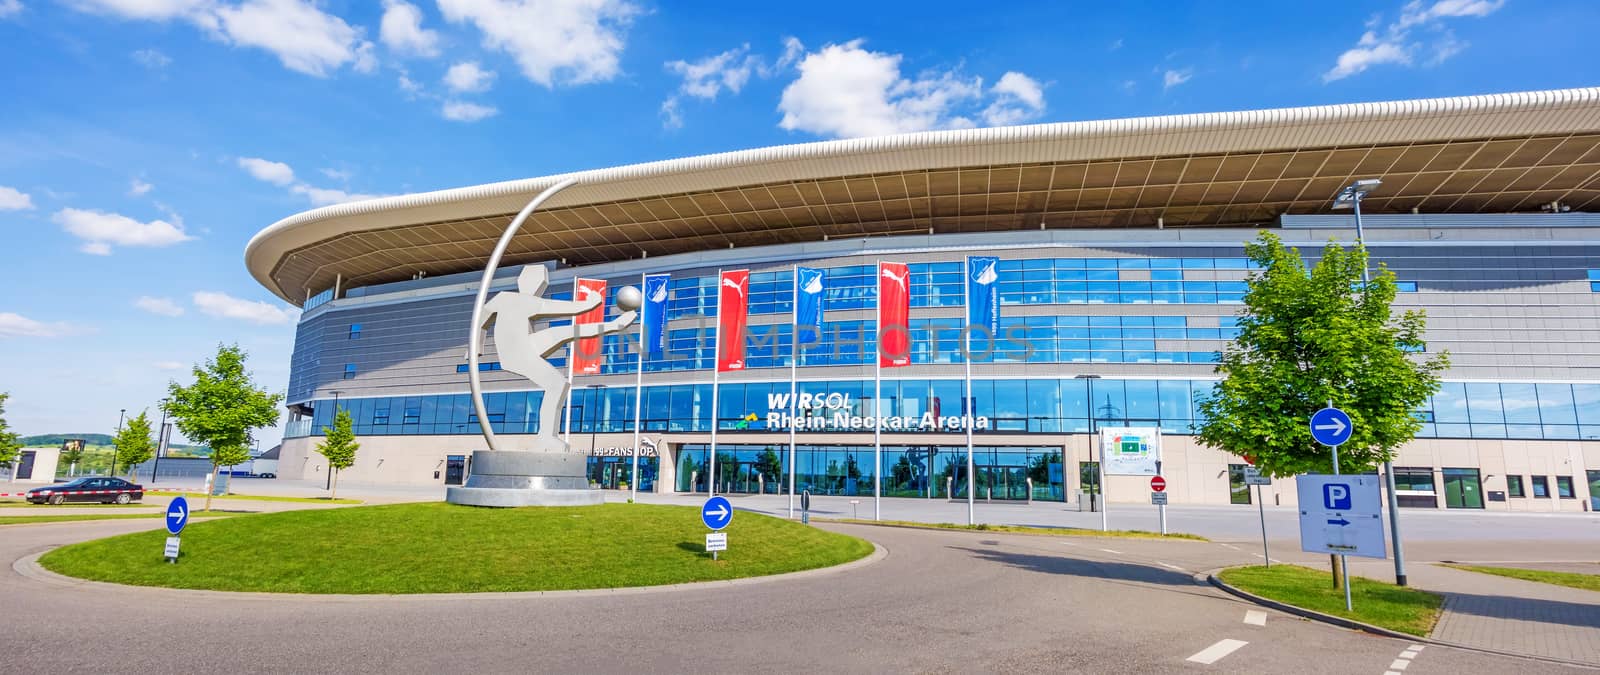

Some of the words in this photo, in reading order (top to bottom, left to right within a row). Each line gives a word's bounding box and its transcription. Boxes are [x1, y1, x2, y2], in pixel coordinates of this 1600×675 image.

[767, 392, 853, 410] WIRSOL
[767, 411, 989, 429] Rhein-Neckar-Arena
[1328, 485, 1347, 508] P
